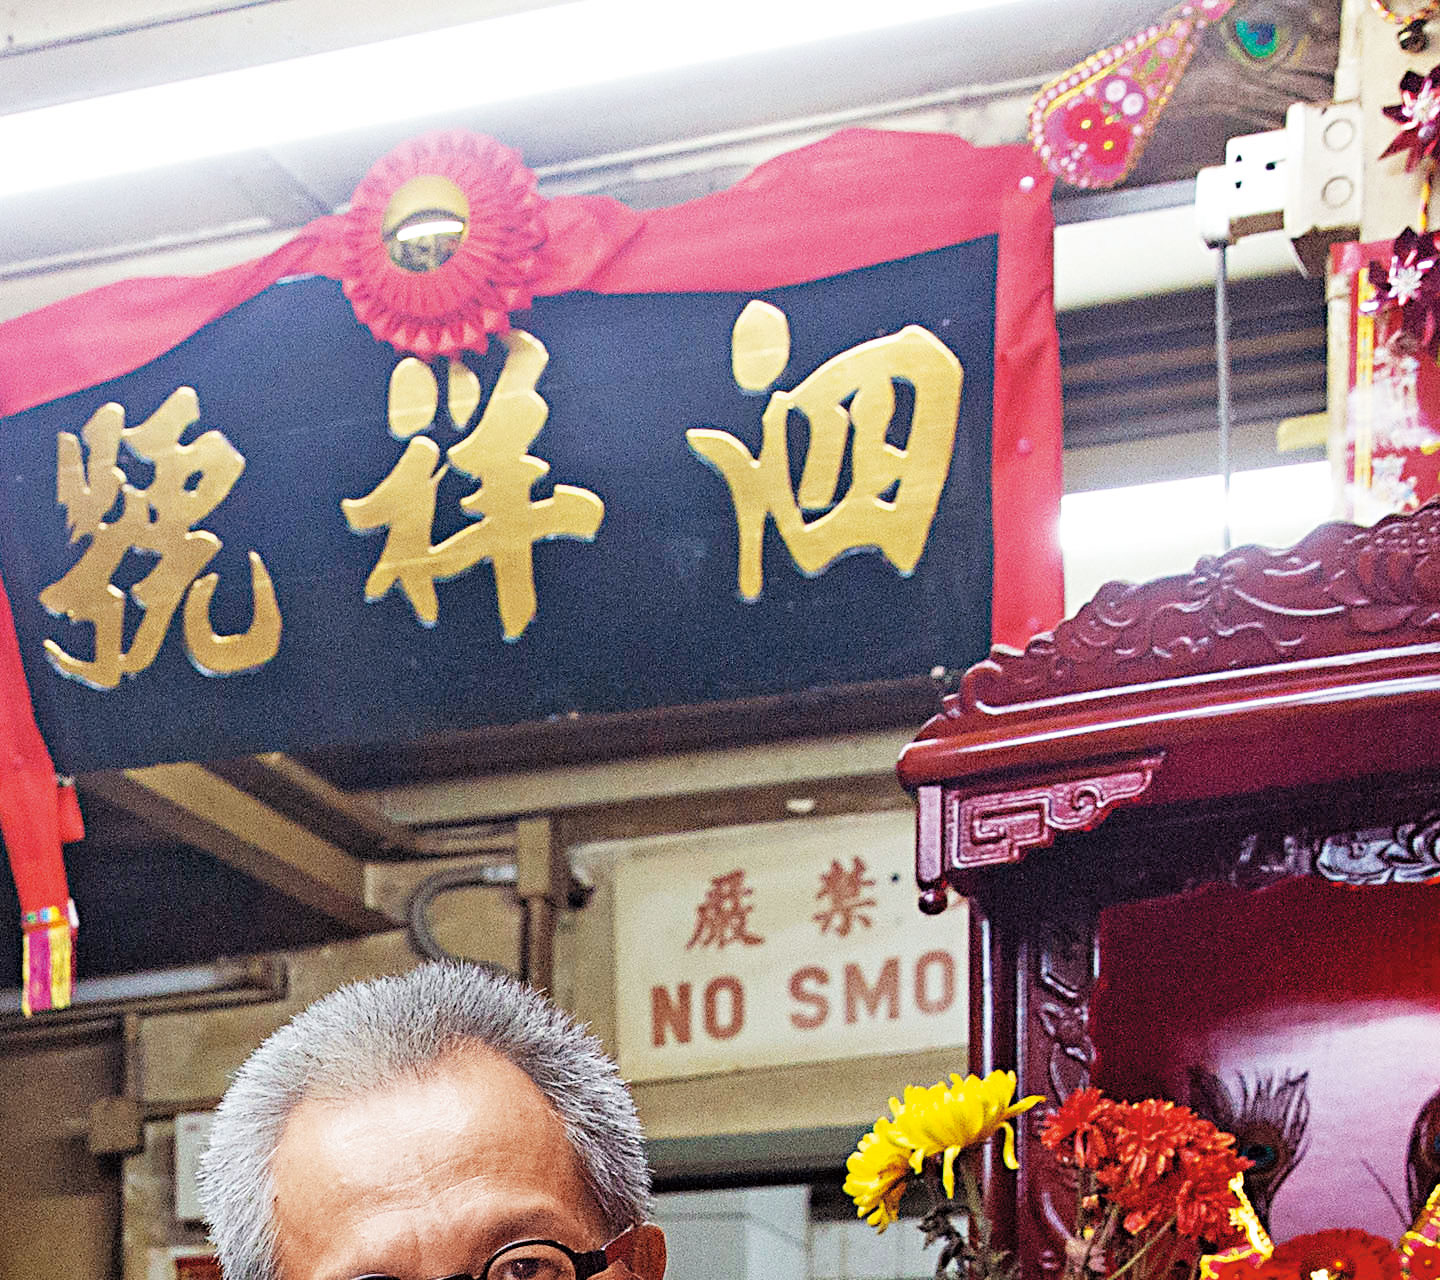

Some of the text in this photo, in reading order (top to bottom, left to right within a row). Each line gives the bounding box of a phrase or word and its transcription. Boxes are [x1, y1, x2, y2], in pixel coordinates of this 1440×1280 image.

[40, 298, 966, 692] 泗祥號
[650, 974, 746, 1048] NO
